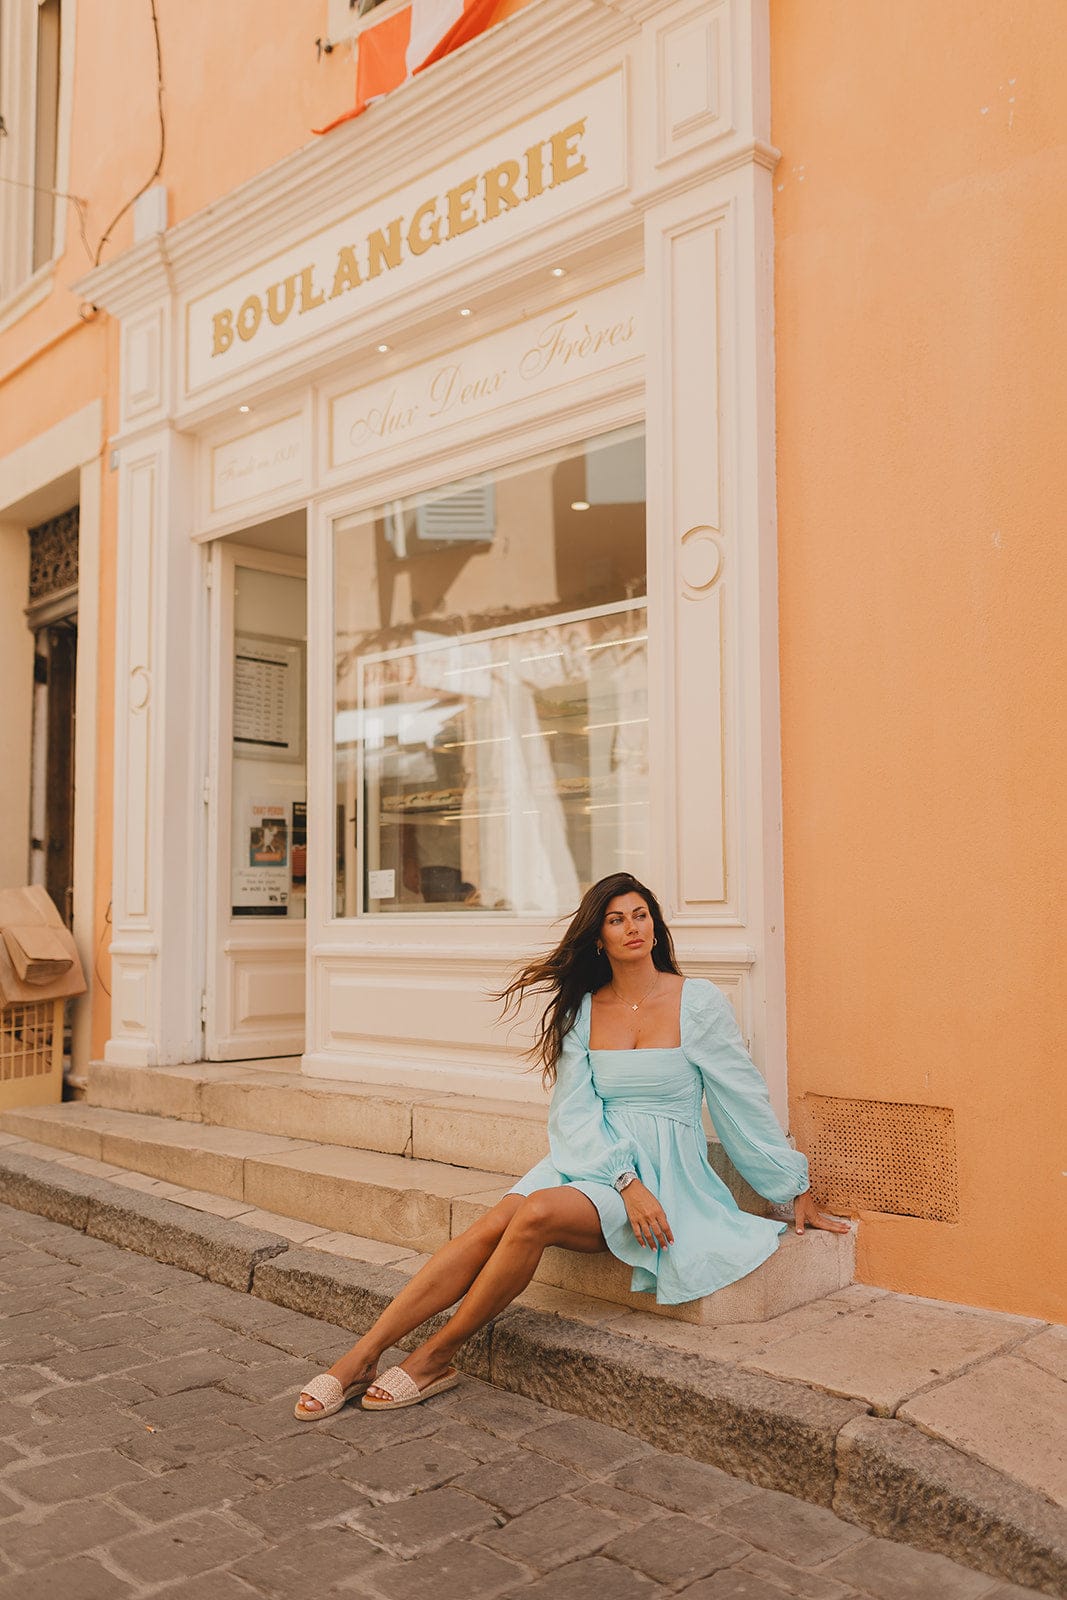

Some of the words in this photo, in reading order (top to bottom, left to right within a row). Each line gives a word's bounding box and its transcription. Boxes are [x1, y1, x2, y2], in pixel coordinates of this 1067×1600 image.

[211, 117, 589, 357] BOULANGERIE
[350, 390, 419, 447] Aux
[429, 362, 507, 418] Deux
[519, 310, 634, 381] Frères
